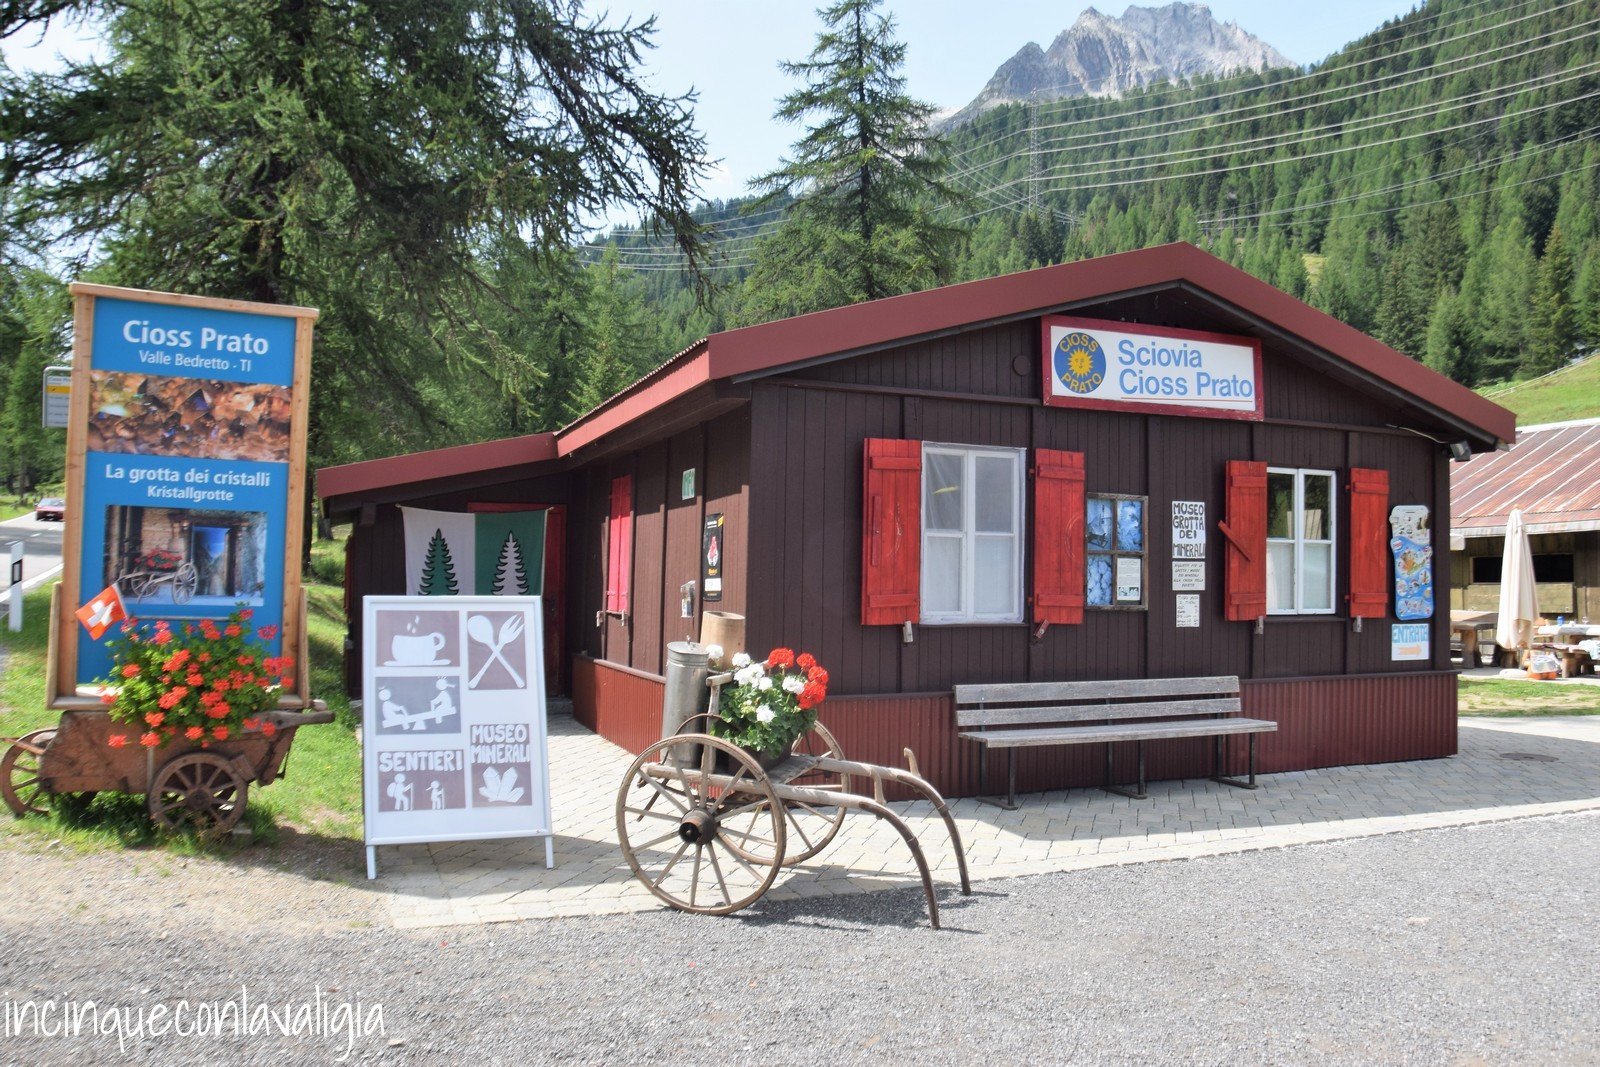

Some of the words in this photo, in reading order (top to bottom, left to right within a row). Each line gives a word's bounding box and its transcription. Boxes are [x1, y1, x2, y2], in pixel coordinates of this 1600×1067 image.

[122, 320, 192, 348] Cioss
[201, 327, 269, 355] Prato
[1059, 333, 1099, 354] CIOSS
[139, 350, 171, 365] Valle
[175, 353, 229, 370] Bedretto
[240, 359, 252, 372] TI
[1118, 339, 1202, 368] Sciovia
[1061, 372, 1102, 393] PRATO
[1119, 368, 1188, 395] Cioss
[1196, 371, 1253, 398] Prato
[105, 464, 124, 479] La
[129, 467, 180, 484] grotta
[184, 469, 209, 484] dei
[213, 471, 270, 487] cristalli
[147, 485, 234, 502] Kristallgrotte
[1173, 503, 1204, 516] MUSEO
[1173, 515, 1205, 531] GROTTA
[1179, 530, 1197, 539] DEI
[1172, 543, 1206, 557] MINERALI
[1392, 625, 1428, 643] ENTRATA
[471, 724, 527, 744] MUSEO
[378, 751, 463, 772] SENTIERI
[471, 744, 530, 764] MINERALI
